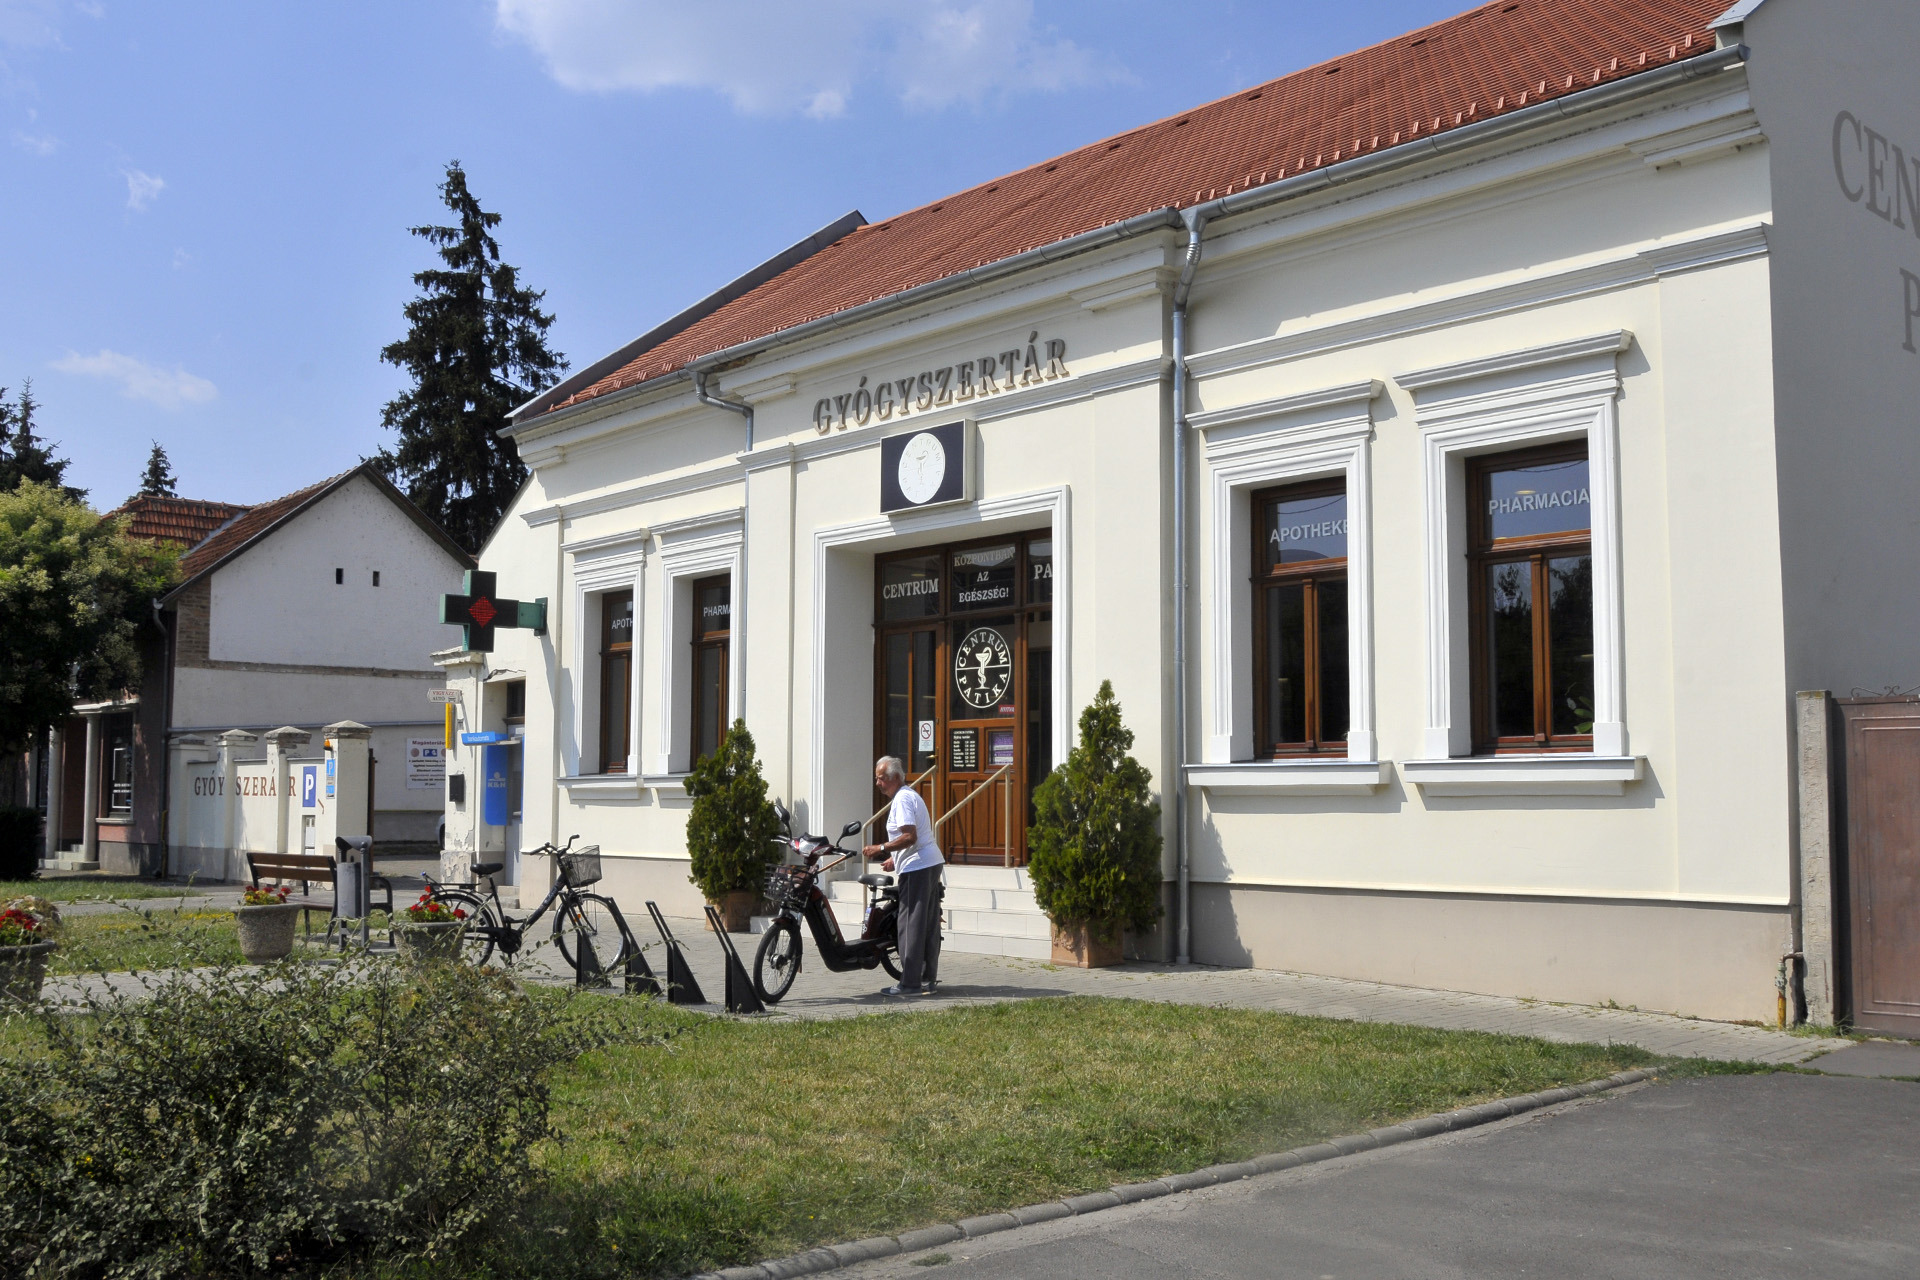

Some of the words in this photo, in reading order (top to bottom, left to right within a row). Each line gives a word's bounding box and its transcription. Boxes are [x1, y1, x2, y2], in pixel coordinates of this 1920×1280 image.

[813, 331, 1070, 435] GYÓGYSZERTÁR
[1489, 488, 1590, 515] PHARMACIA
[883, 578, 939, 599] CENTRUM
[976, 571, 990, 582] AZ
[958, 586, 1009, 603] EGÉSZSÉG!
[958, 632, 1008, 667] CENTRUM
[958, 673, 1008, 704] PATIKA
[305, 774, 314, 801] P
